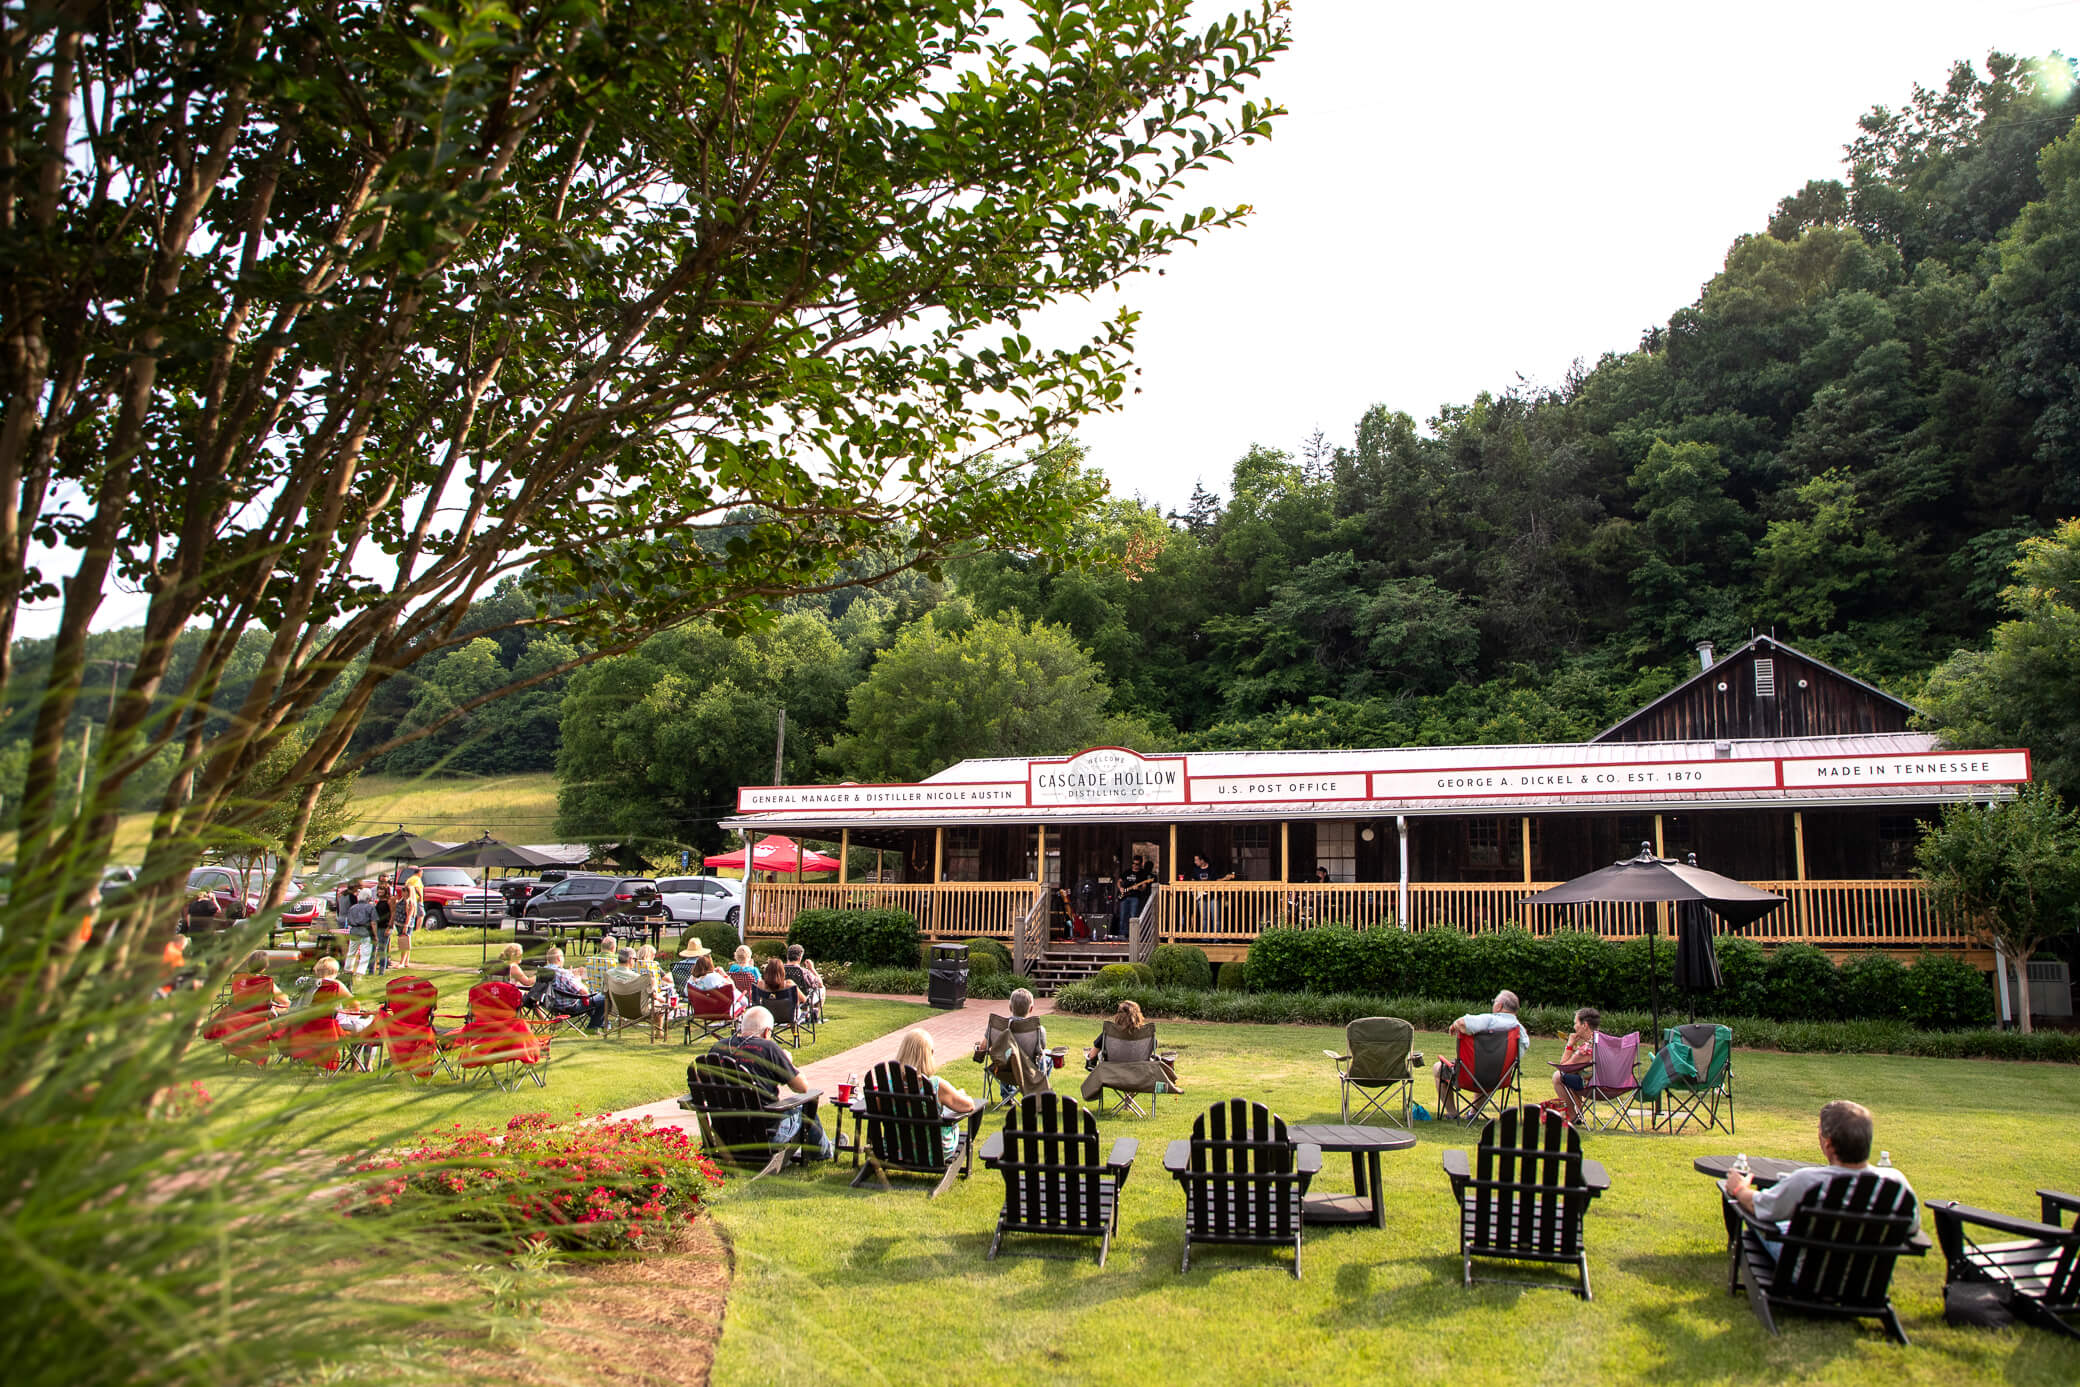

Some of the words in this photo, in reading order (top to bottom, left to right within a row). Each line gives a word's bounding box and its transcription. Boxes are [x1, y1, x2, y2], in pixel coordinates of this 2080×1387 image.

[1088, 756, 1125, 764] WELCOME
[1818, 766, 1861, 777] MADE
[1869, 765, 1886, 776] IN
[1893, 762, 1989, 775] TENNESSEE
[1038, 773, 1107, 787] CASCADE
[1114, 771, 1176, 786] HOLLOW
[1437, 777, 1493, 788] GEORGE
[1500, 777, 1513, 786] A.
[1521, 775, 1573, 786] DICKEL
[1580, 774, 1589, 784] &
[1628, 772, 1660, 783] EST.
[1667, 771, 1702, 781] 1870
[1068, 788, 1127, 798] DISTILLING
[1218, 785, 1243, 794] U.S.
[1249, 784, 1282, 793] POST
[1289, 782, 1336, 792] OFFICE
[752, 795, 796, 804] GENERAL
[801, 794, 850, 803] MANAGER
[854, 794, 860, 802] &
[866, 793, 921, 802] DISTILLER
[926, 791, 966, 800] NICOLE
[971, 791, 1012, 800] AUSTIN
